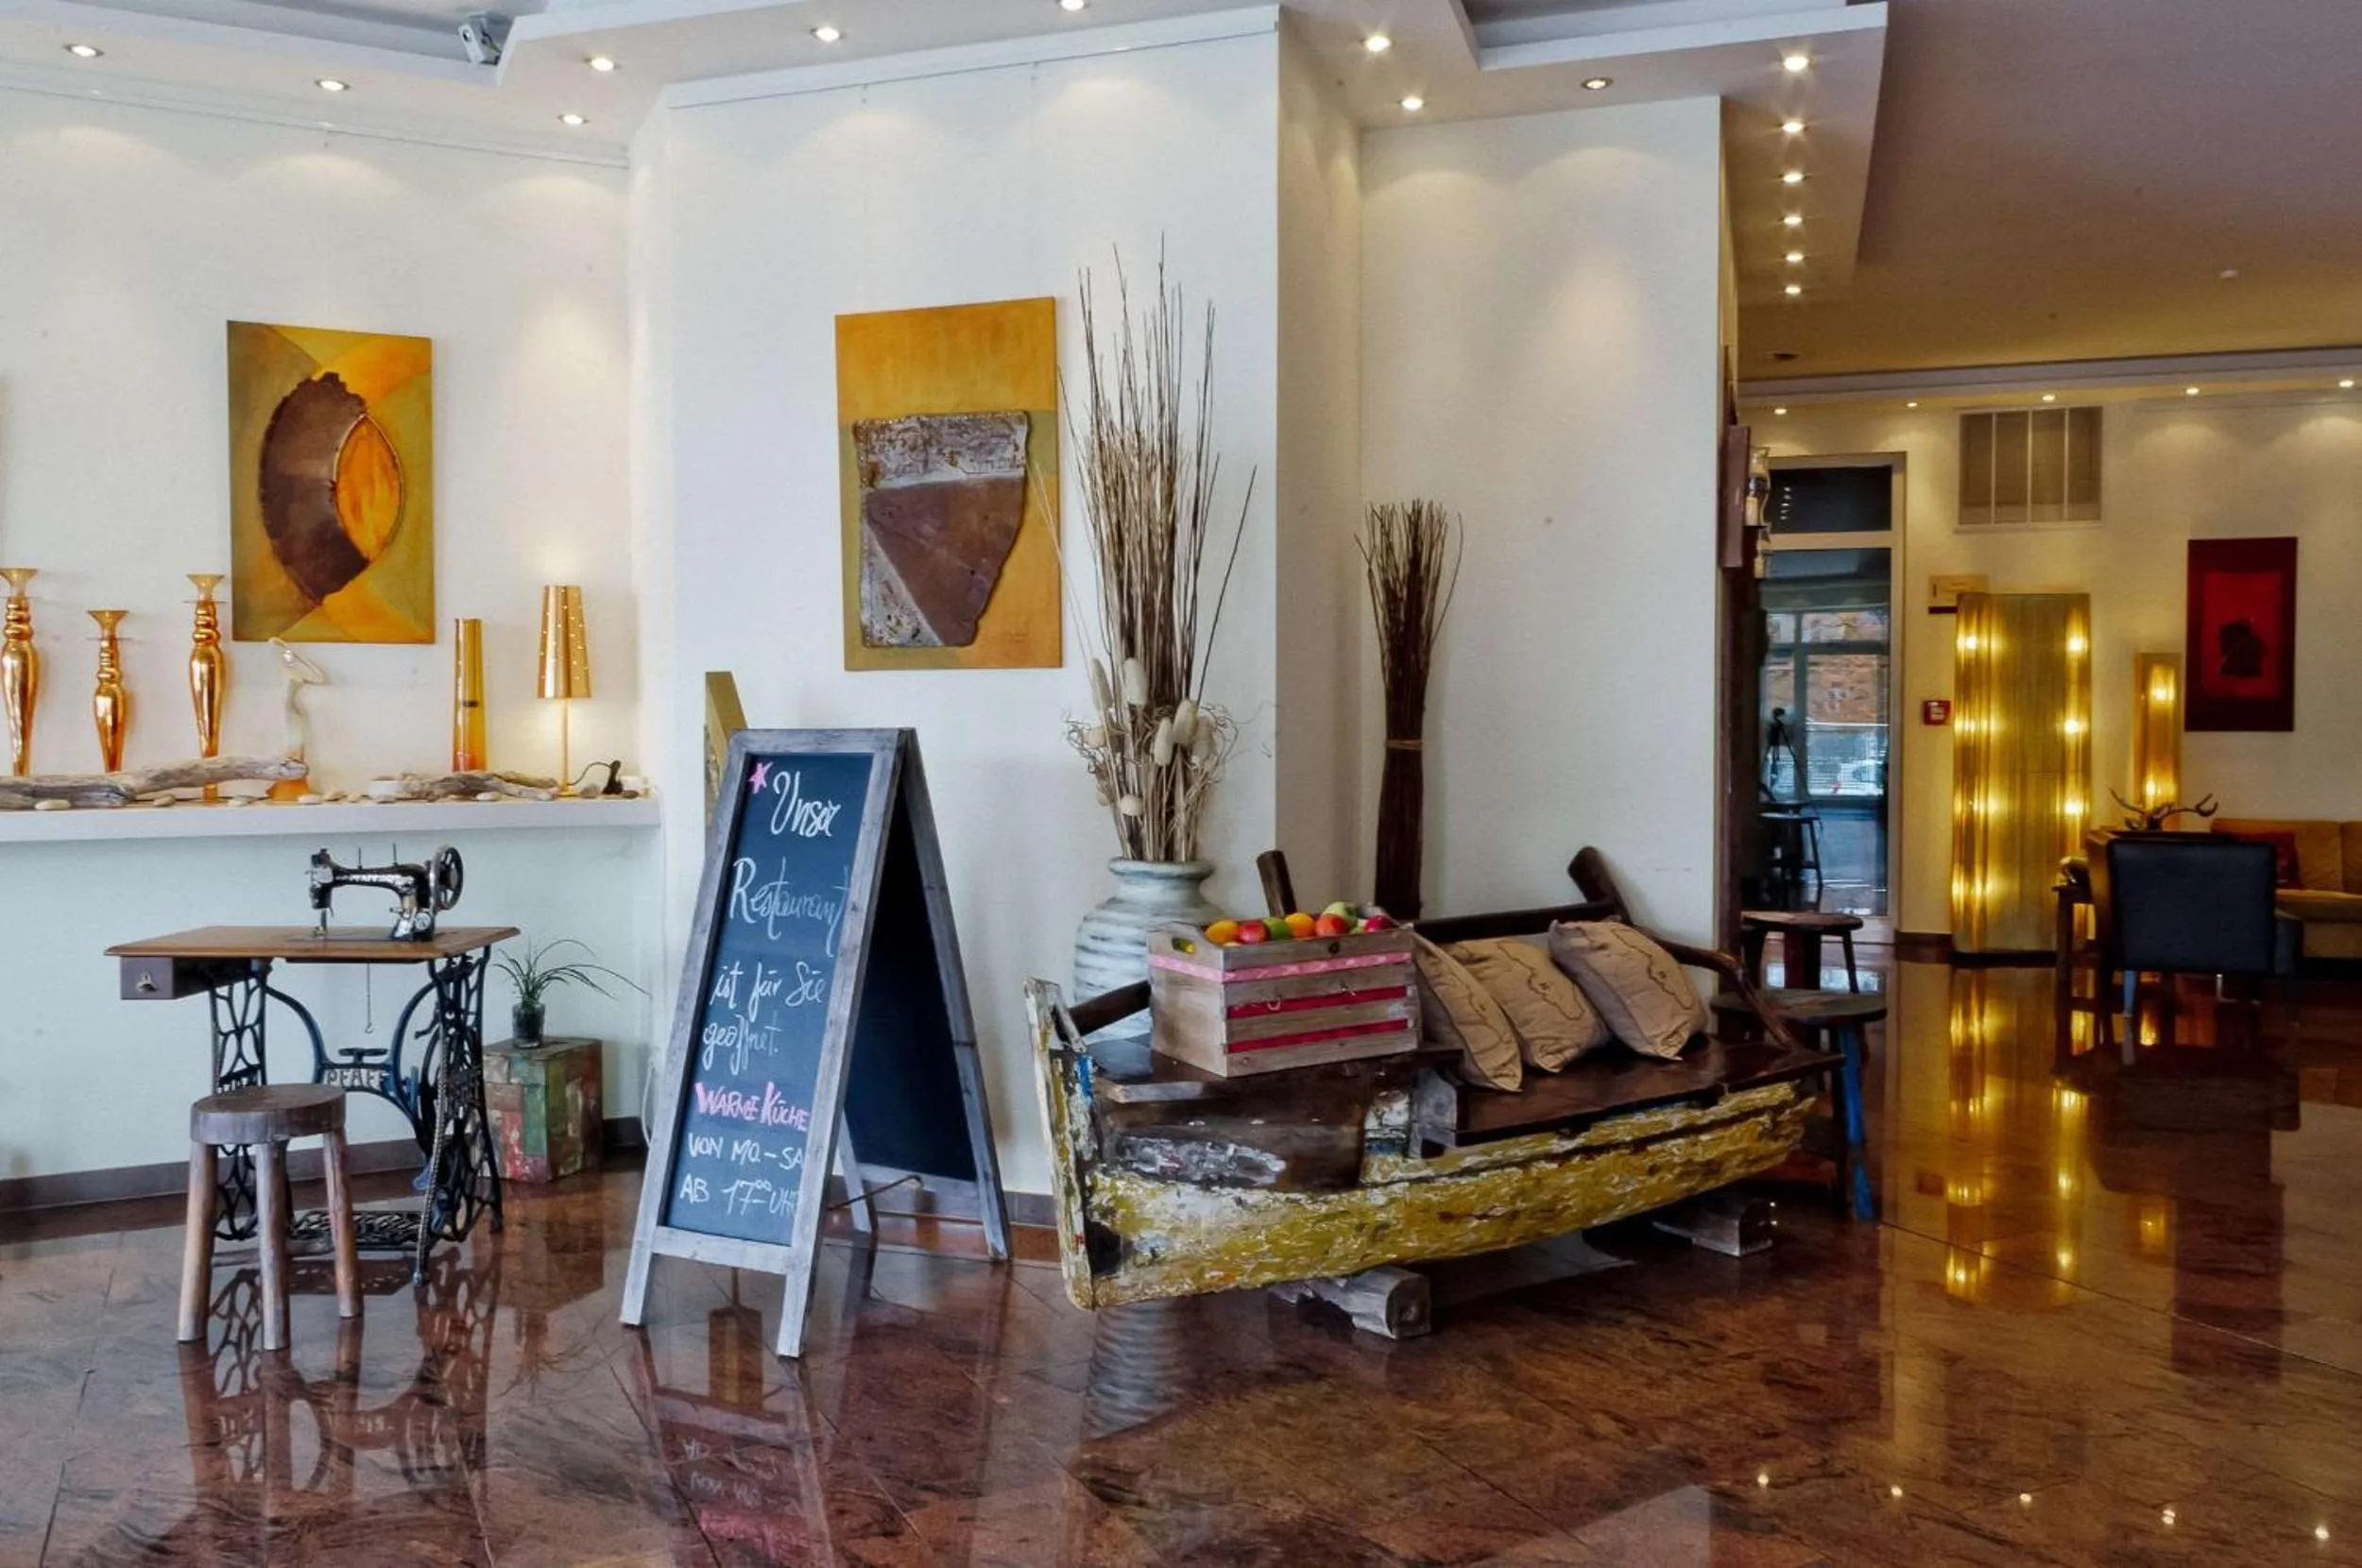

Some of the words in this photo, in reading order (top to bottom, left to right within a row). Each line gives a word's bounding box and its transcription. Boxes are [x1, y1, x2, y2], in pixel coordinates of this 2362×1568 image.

[710, 961, 744, 1009] ist
[747, 960, 783, 1022] für
[784, 962, 827, 1008] Sie
[688, 1133, 724, 1159] VON
[679, 1172, 710, 1204] AB
